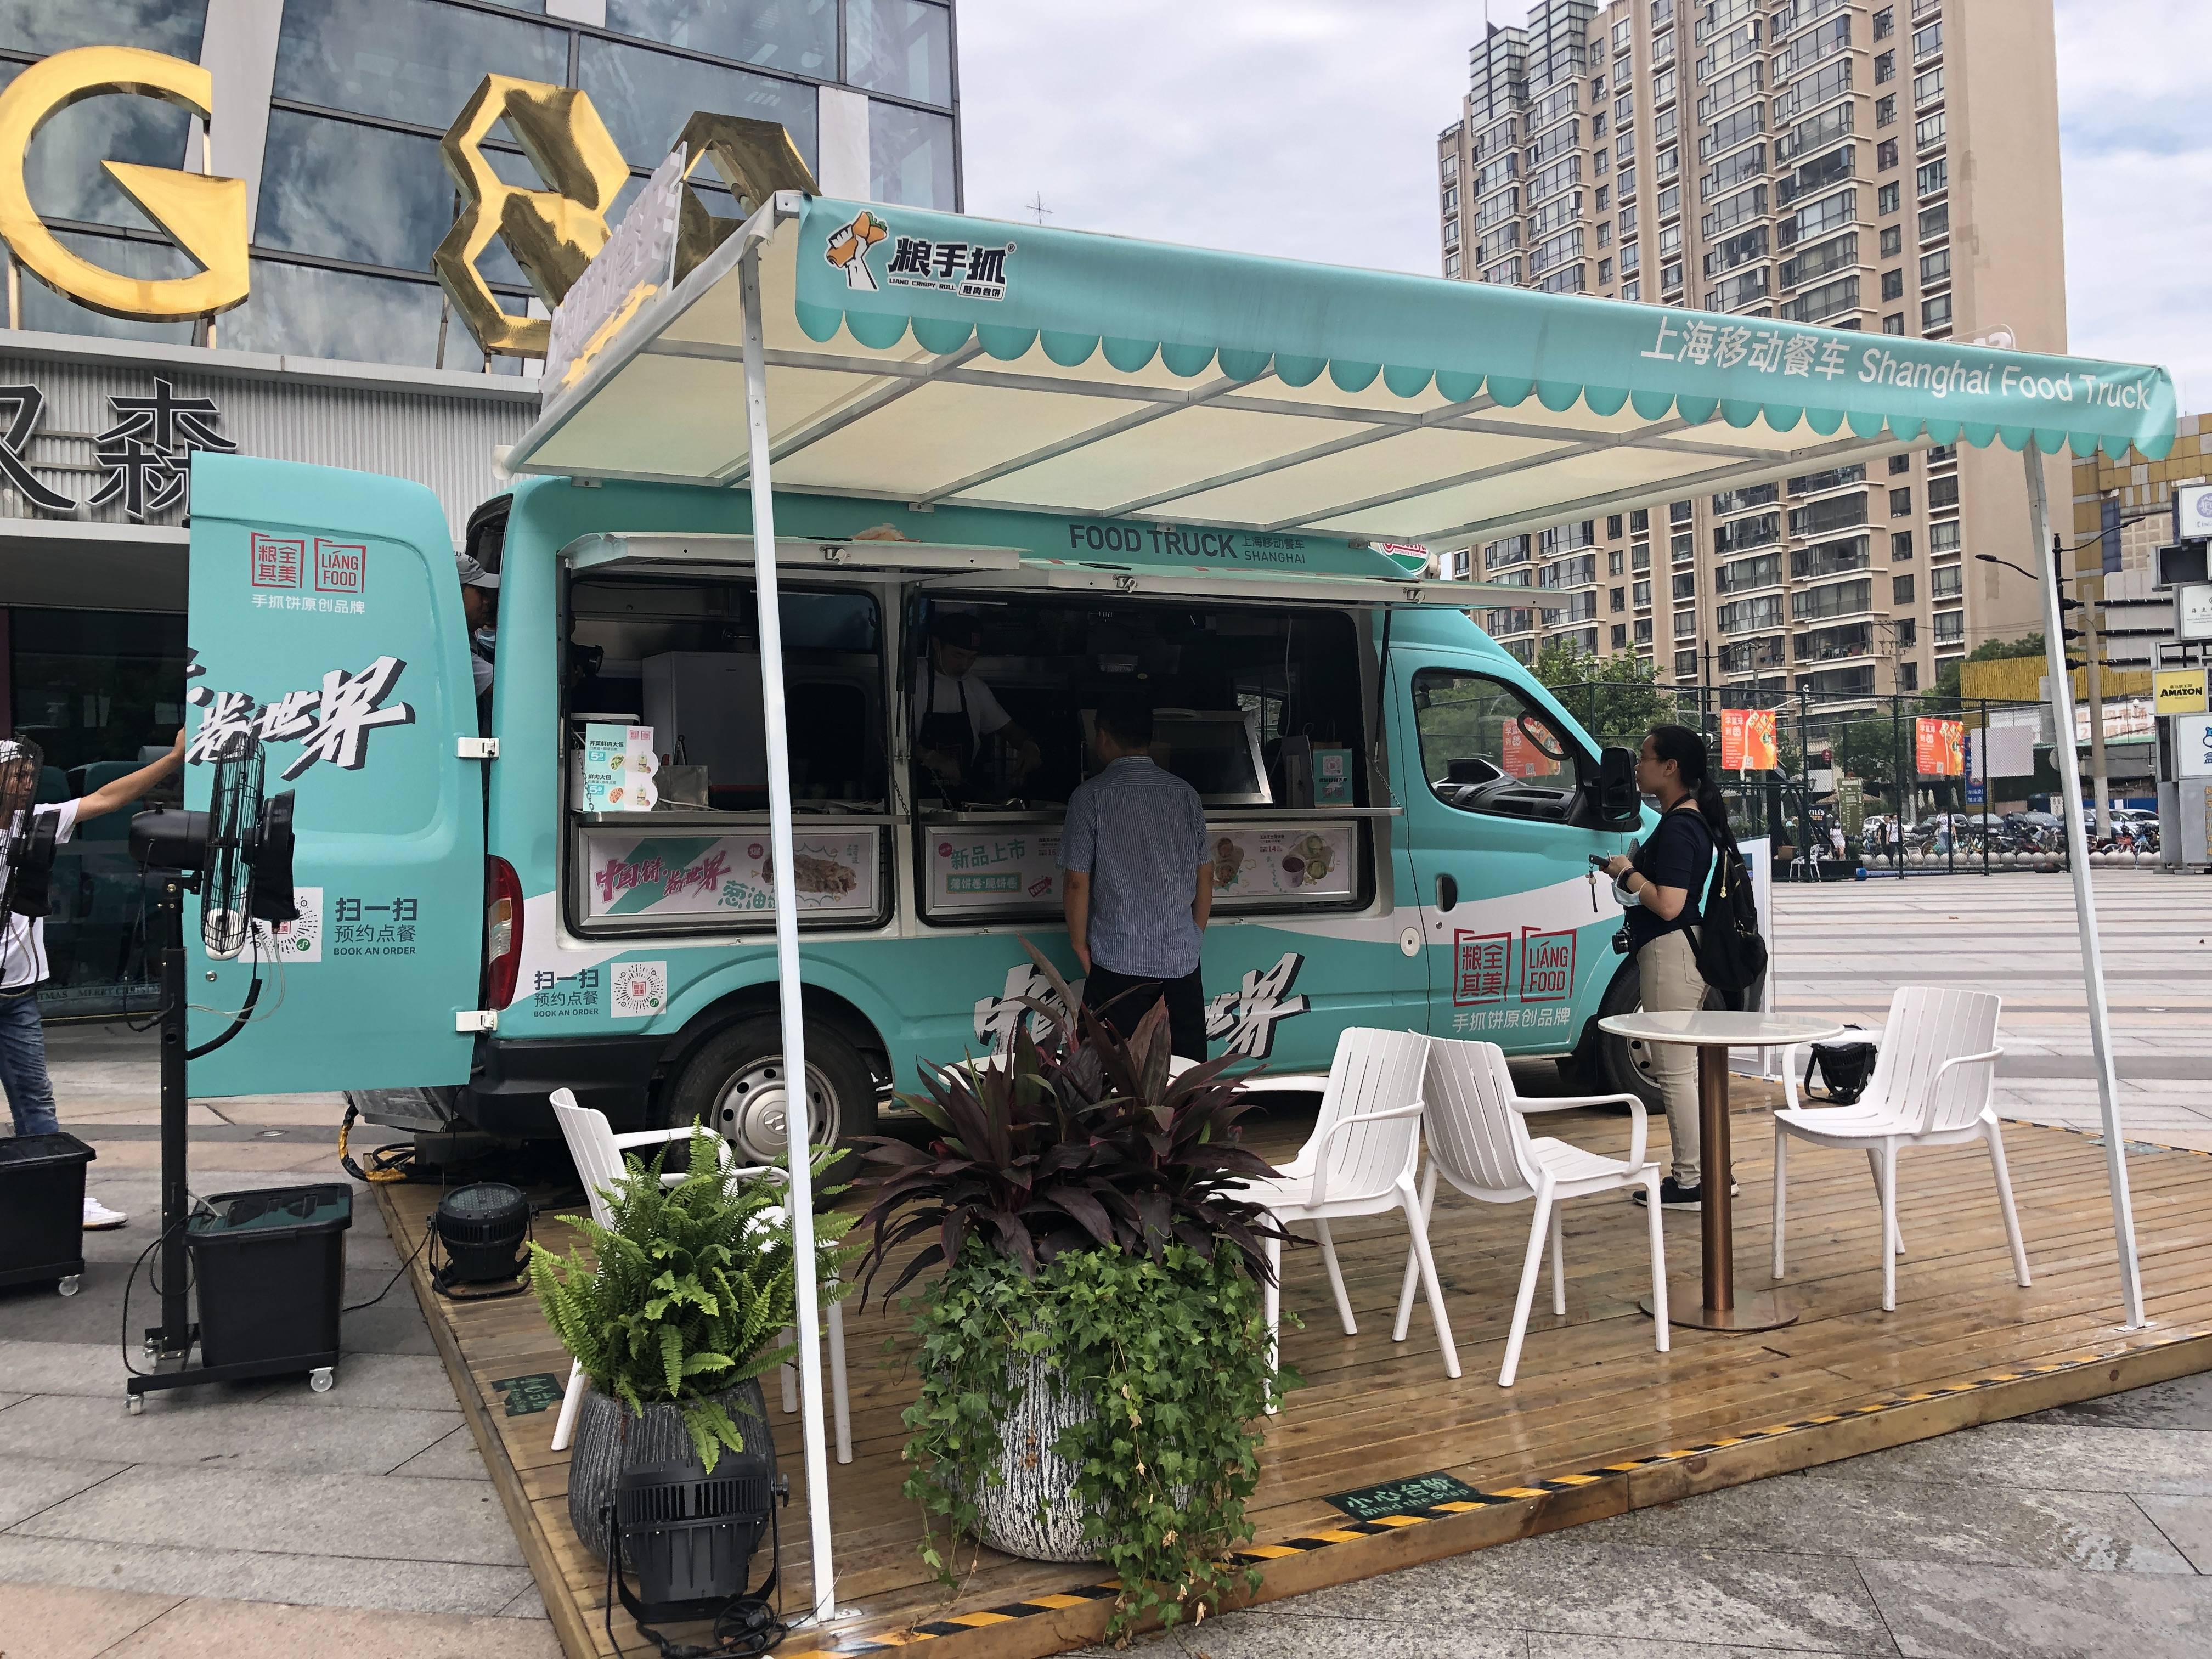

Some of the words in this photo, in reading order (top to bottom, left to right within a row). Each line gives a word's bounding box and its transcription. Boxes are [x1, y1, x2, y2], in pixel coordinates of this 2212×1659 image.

[888, 237, 1006, 285] 粮手抓
[912, 280, 936, 289] CRISPY
[1640, 315, 1850, 381] 上海移动餐车
[1858, 347, 1990, 399] Shanghai
[2001, 365, 2073, 402] Food
[2079, 373, 2151, 410] Truck
[1069, 524, 1142, 552] FOOD
[1146, 529, 1238, 559] TRUCK
[1242, 535, 1306, 551] 上海移动餐车
[258, 545, 298, 563] 粮全
[1244, 553, 1307, 565] SHANGHAI
[258, 563, 297, 583] 其美
[323, 570, 357, 587] FOOD
[251, 594, 365, 615] 手抓饼原创品牌
[951, 839, 1025, 870] 新品上市
[335, 896, 417, 923] 扫一扫
[334, 924, 416, 944] 预约点餐
[334, 947, 361, 955] BOOK
[364, 947, 379, 955] AN
[382, 946, 416, 955] ORDER
[1462, 943, 1503, 970] 粮全
[534, 969, 599, 990] 扫一扫
[1460, 972, 1502, 997] 其美
[1530, 970, 1565, 992] FOOD
[534, 991, 599, 1007] 预约点餐
[1452, 1006, 1570, 1033] 手抓饼原创品牌
[1359, 1502, 1404, 1517] Mind
[1404, 1497, 1430, 1506] the
[1431, 1488, 1469, 1502] Step
